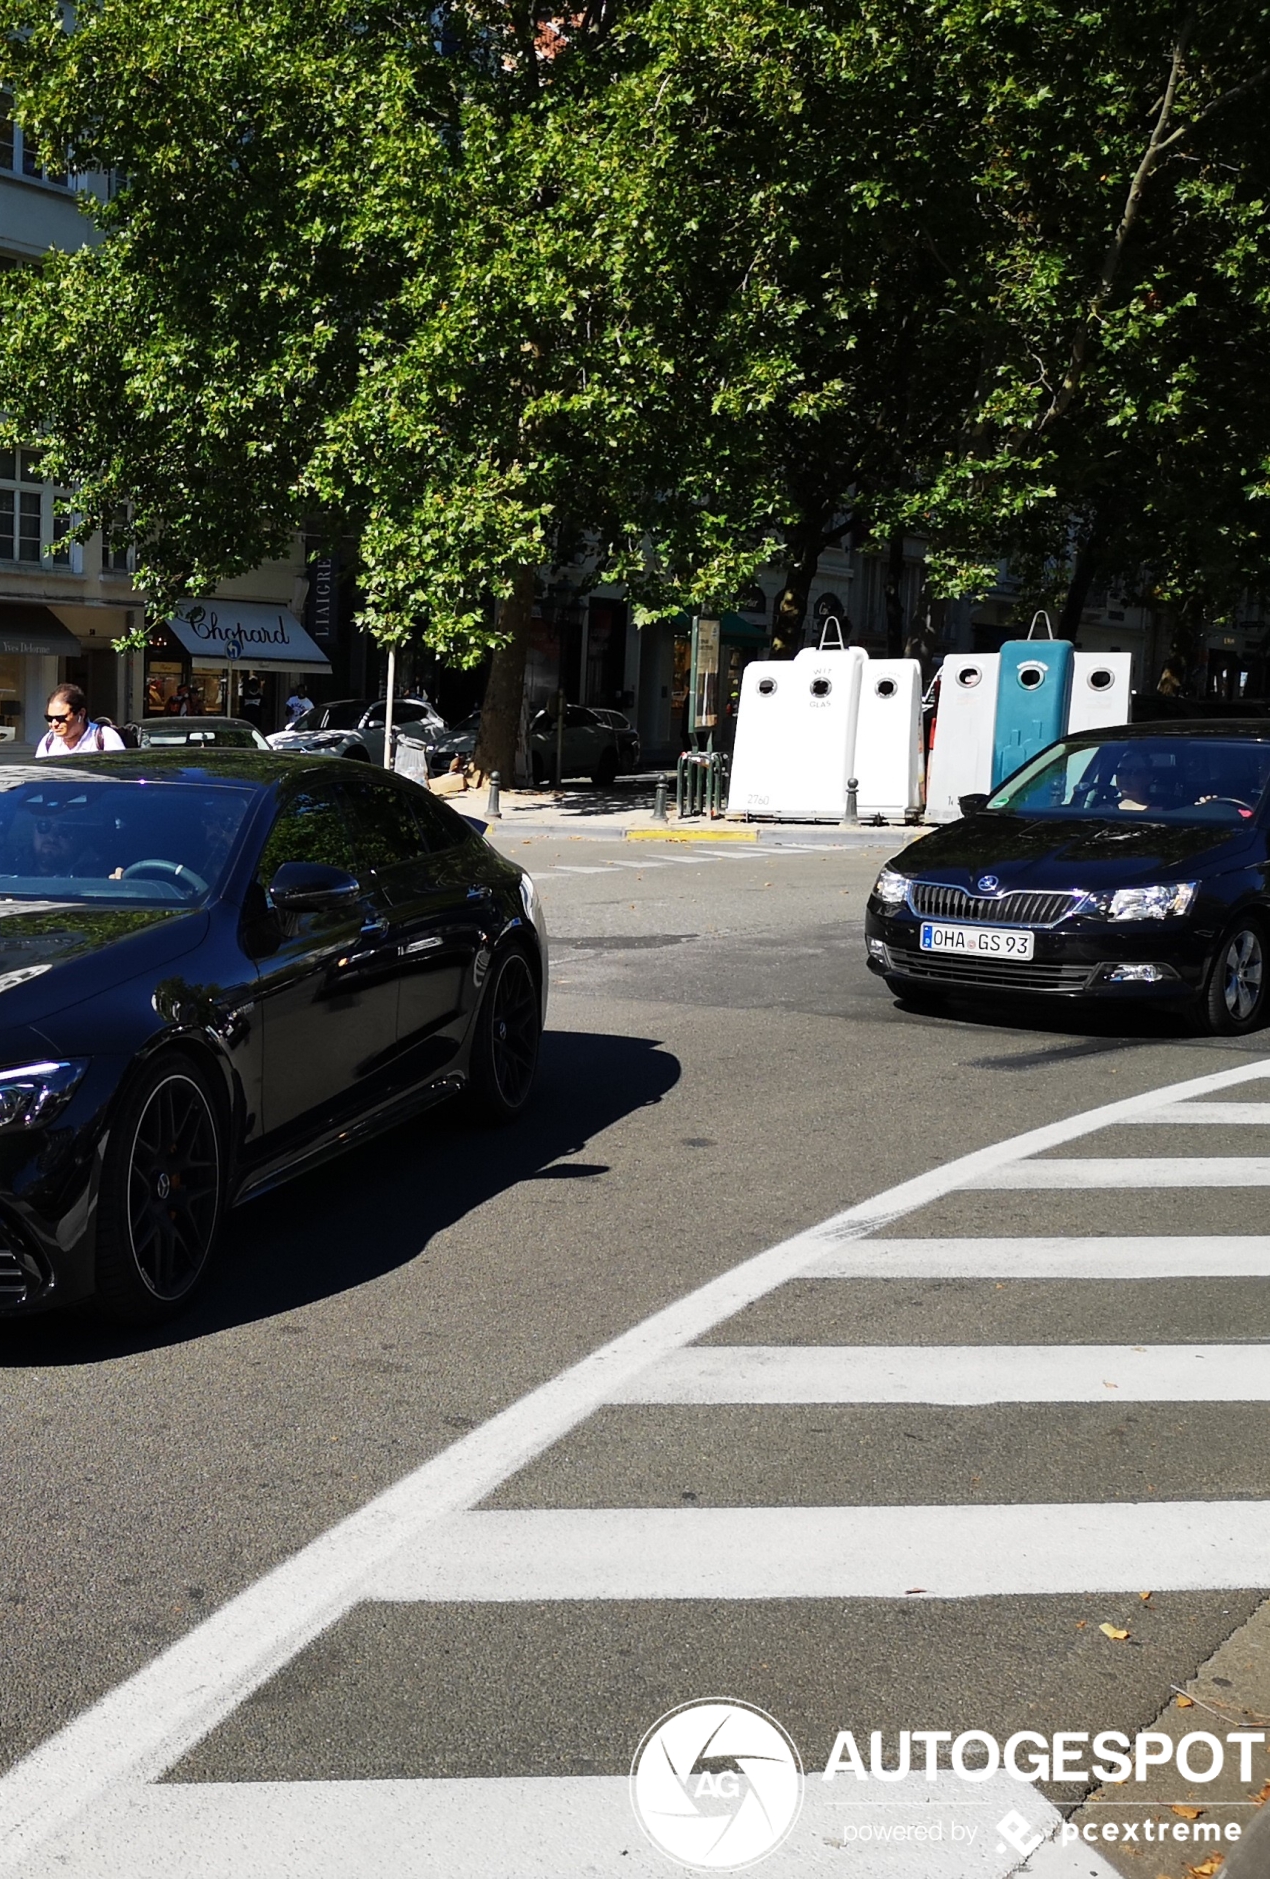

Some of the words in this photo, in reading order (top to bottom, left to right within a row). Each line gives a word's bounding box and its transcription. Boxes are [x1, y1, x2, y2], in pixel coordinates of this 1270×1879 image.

[315, 558, 331, 636] LIAIGRE
[176, 606, 290, 650] Chopard
[3, 641, 19, 652] Yves
[20, 642, 50, 654] Delorme
[809, 700, 831, 708] GLAS
[747, 794, 769, 806] 2760
[933, 930, 965, 948] OHA
[978, 934, 1001, 952] GS
[1006, 937, 1028, 954] 93
